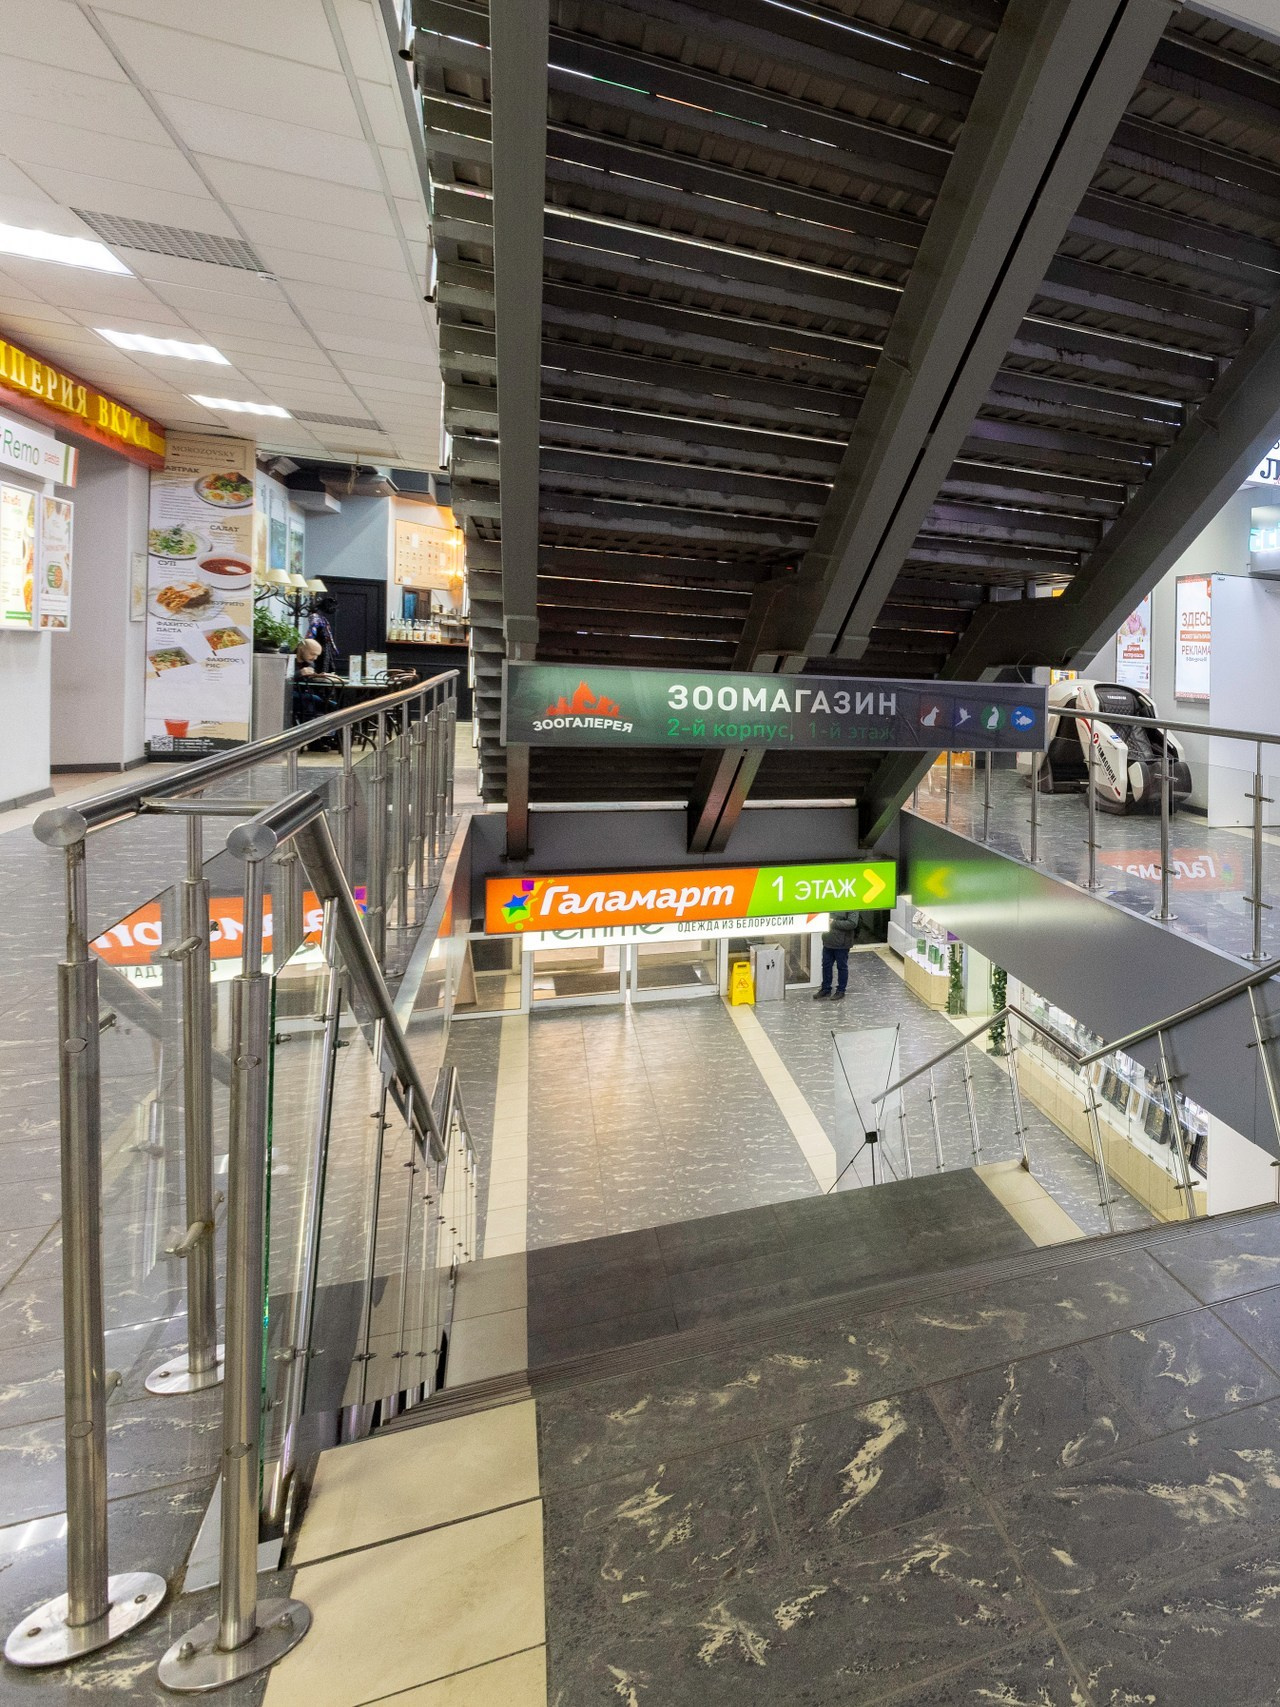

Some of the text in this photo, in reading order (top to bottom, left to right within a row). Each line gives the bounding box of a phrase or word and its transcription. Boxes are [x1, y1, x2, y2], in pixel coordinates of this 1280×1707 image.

[98, 395, 150, 447] ВКУСА
[3, 429, 40, 465] Remo
[172, 445, 235, 457] MOROZOVSKY
[164, 465, 200, 474] АВТРАК
[210, 524, 240, 532] САЛАТ
[1182, 611, 1211, 629] ЗДЕСЬ
[668, 684, 897, 716] ЗООМАГАЗИН
[532, 717, 634, 733] ЗООГАЛЕРЕЯ
[667, 718, 897, 742] 2-й корпус, 1-й этаж
[771, 876, 856, 902] 1 ЭТАЖ
[540, 884, 735, 916] Галамарт
[678, 916, 794, 933] ОДЕЖДА ИЗ БЕЛОРУССИИ
